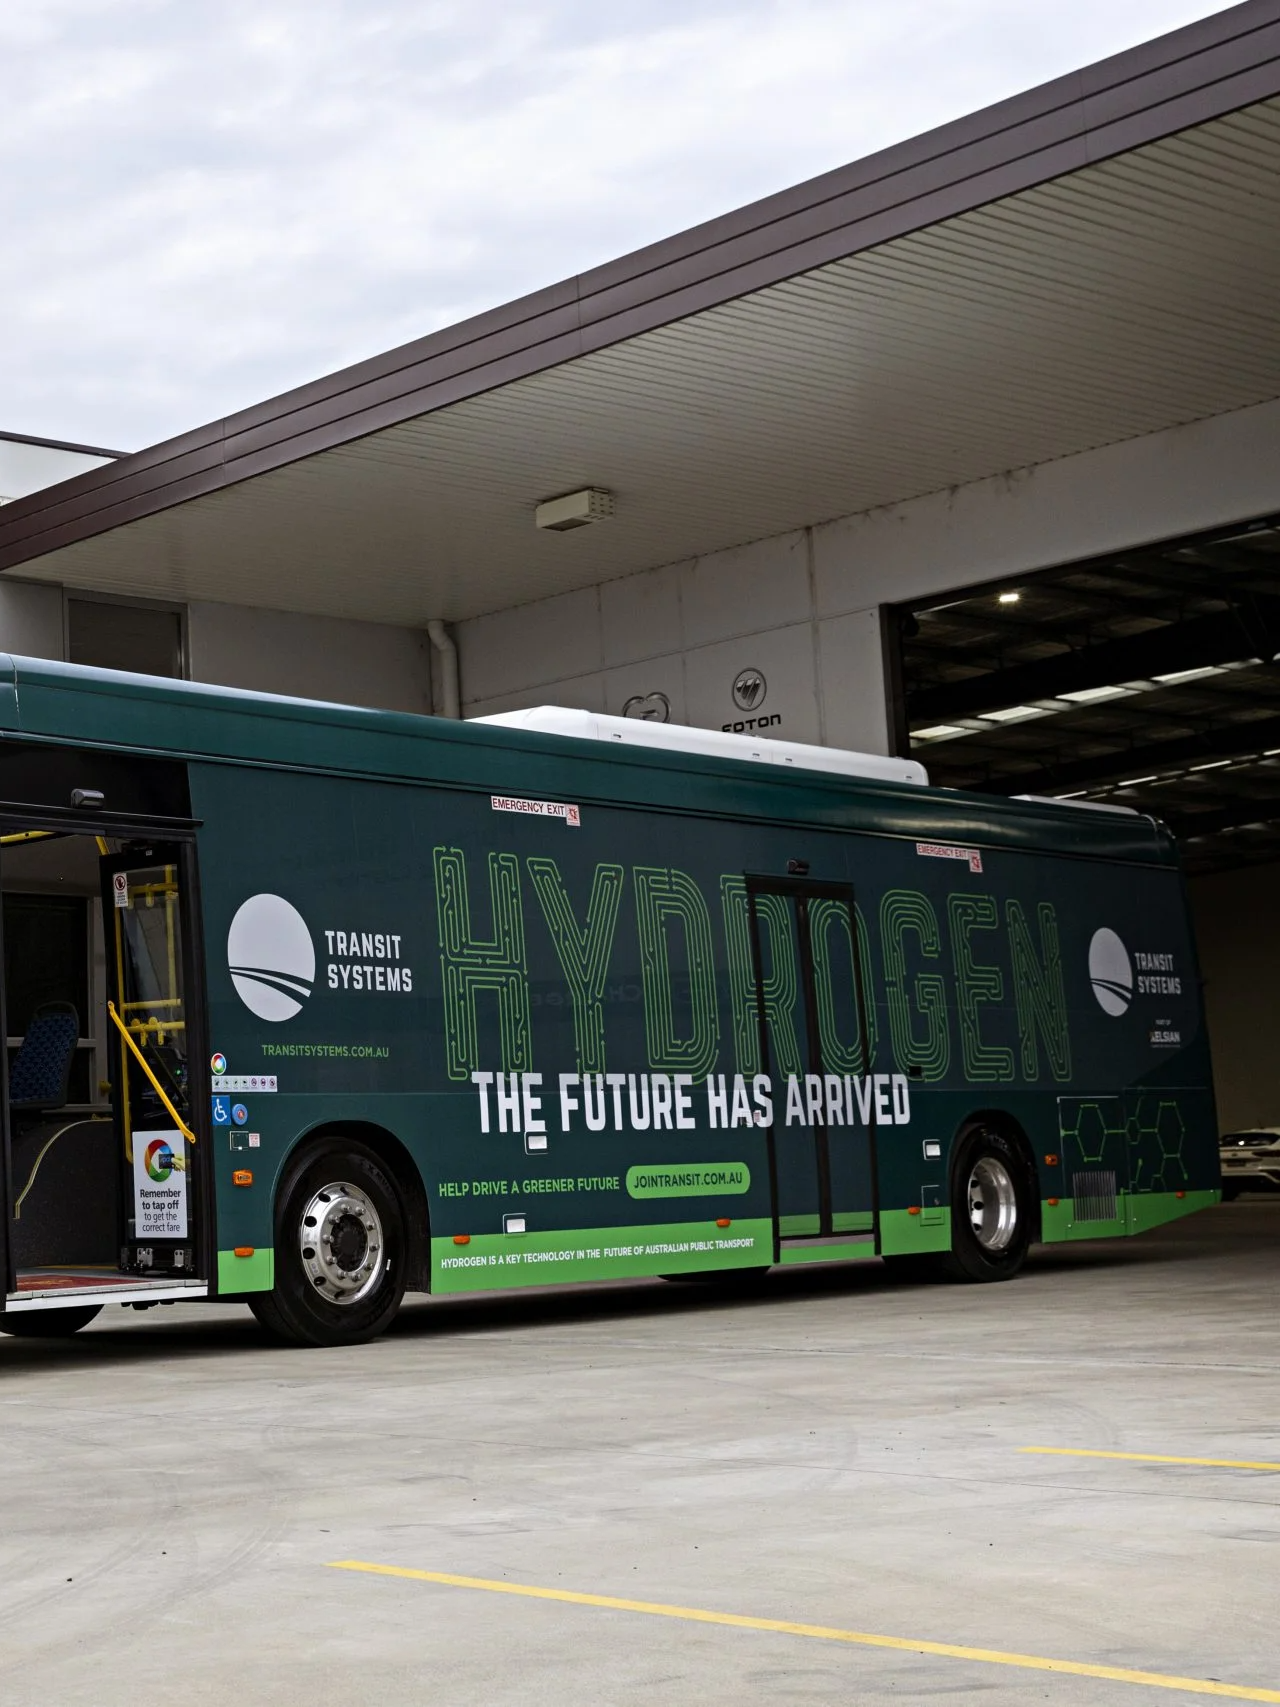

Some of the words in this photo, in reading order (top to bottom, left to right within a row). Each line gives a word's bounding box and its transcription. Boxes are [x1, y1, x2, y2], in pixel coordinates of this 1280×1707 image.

[722, 714, 781, 733] FOTON
[493, 798, 544, 813] EMERGENCY
[547, 804, 565, 816] EXIT
[918, 844, 954, 857] EMERGENCY
[955, 849, 967, 858] EXIT
[325, 931, 401, 959] TRANSIT
[433, 846, 1072, 1085] HYDROGEN
[1134, 953, 1173, 971] TRANSIT
[328, 964, 412, 992] SYSTEMS
[1138, 976, 1182, 994] SYSTEMS
[262, 1045, 389, 1058] TRANSITSYSTEMS.COM.AU
[471, 1072, 546, 1133] THE
[559, 1073, 696, 1132] FUTURE
[707, 1074, 773, 1128] HAS
[785, 1074, 911, 1127] ARRIVED
[439, 1183, 469, 1197] HELP
[472, 1181, 508, 1196] DRIVE
[511, 1180, 520, 1194] A
[522, 1178, 575, 1193] GREENER
[577, 1176, 620, 1191] FUTURE
[634, 1172, 743, 1189] JOINTRANSIT.COM.AU
[140, 1188, 181, 1198] Remember
[142, 1202, 150, 1210] to
[152, 1202, 165, 1212] tap
[167, 1200, 179, 1210] off
[144, 1212, 151, 1221] to
[154, 1212, 164, 1223] get
[166, 1211, 177, 1220] the
[142, 1224, 165, 1232] correct
[167, 1222, 180, 1232] fare
[441, 1256, 487, 1269] HYDROGEN
[489, 1256, 496, 1265] IS
[498, 1256, 504, 1265] A
[506, 1255, 521, 1264] KEY
[523, 1250, 575, 1263] TECHNOLOGY
[576, 1250, 584, 1259] IN
[586, 1248, 600, 1258] THE
[604, 1246, 632, 1257] FUTURE
[633, 1245, 644, 1255] OF
[645, 1242, 689, 1254] AUSTRALIAN
[690, 1240, 714, 1250] PUBLIC
[715, 1238, 754, 1249] TRANSPORT
